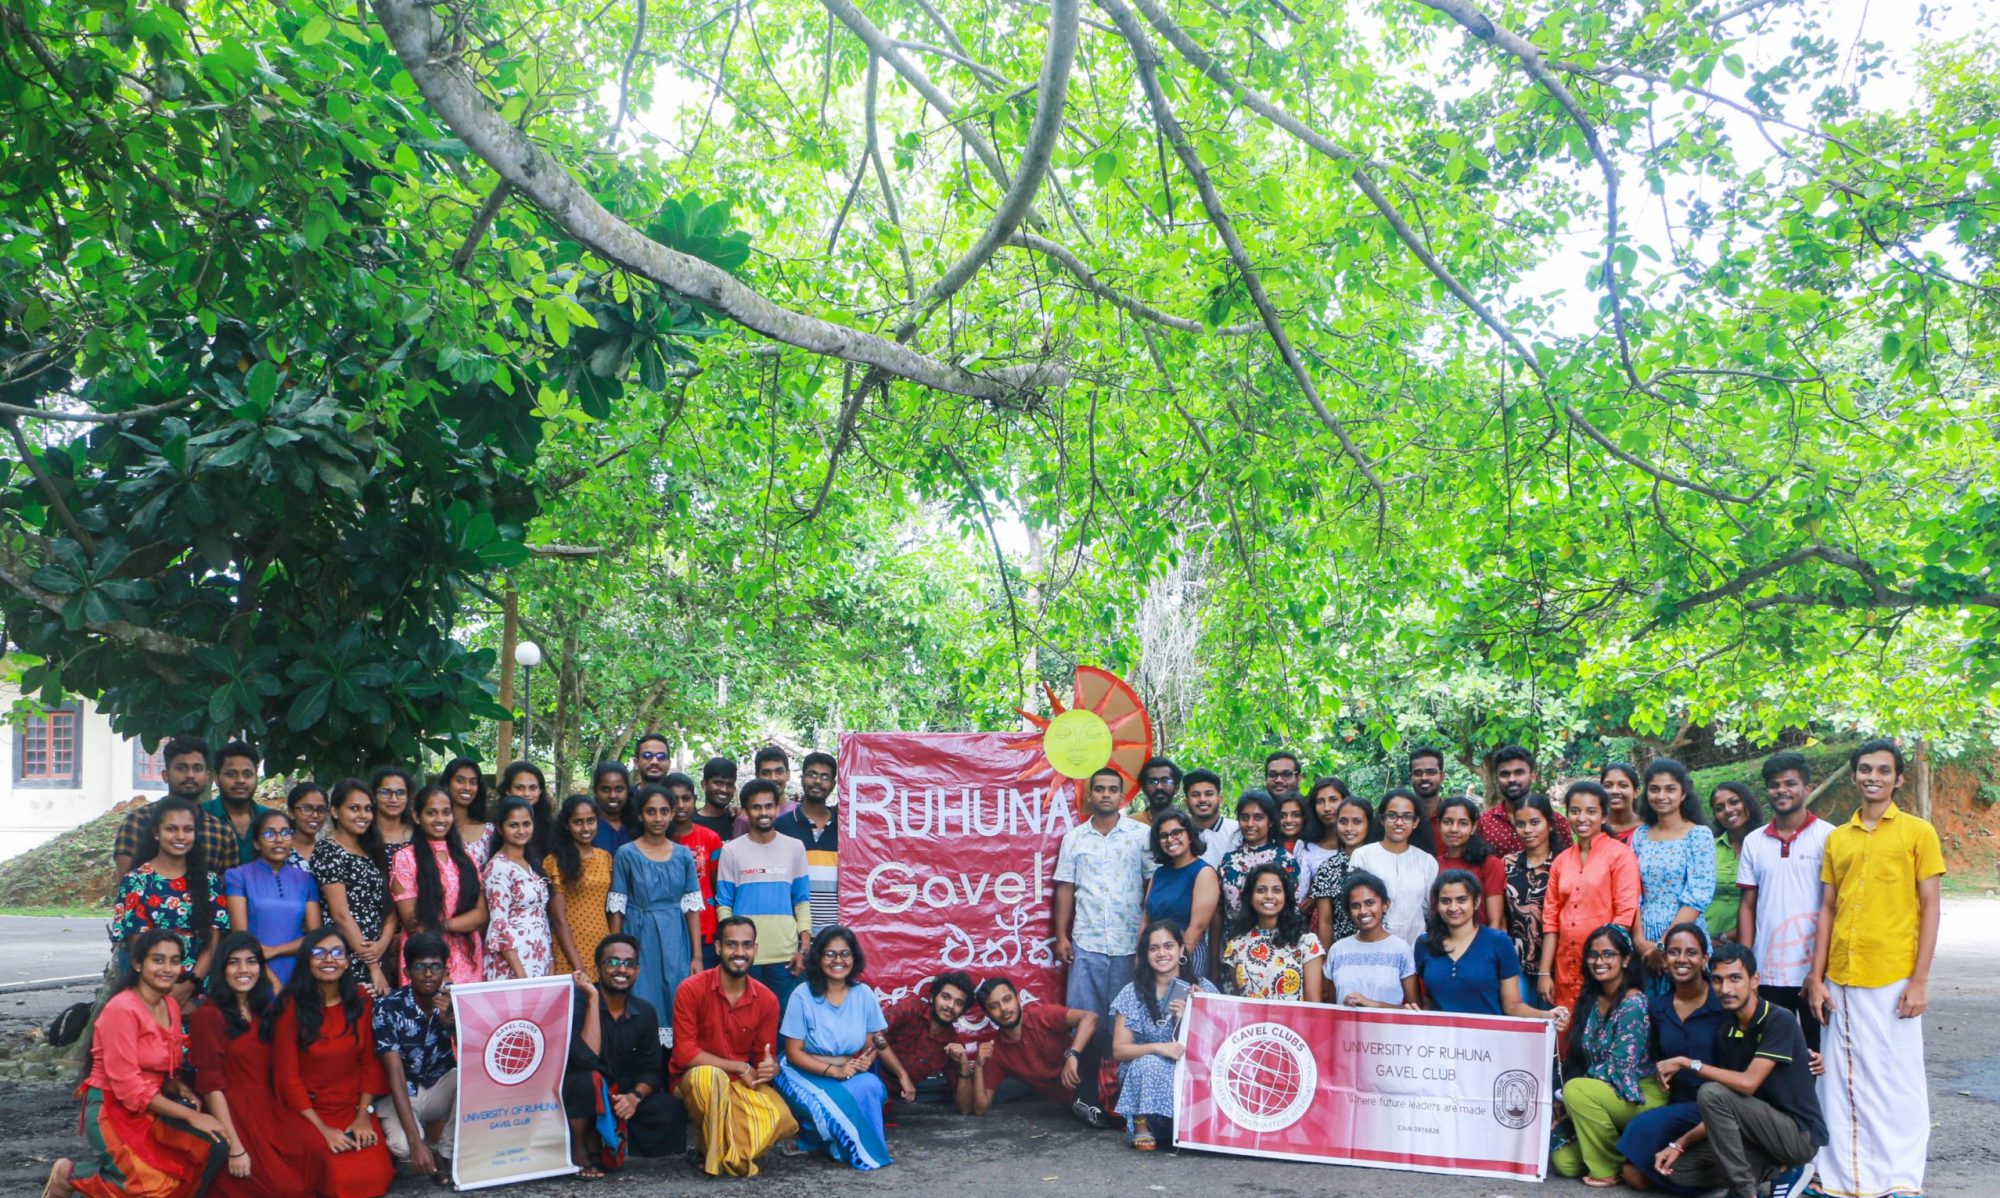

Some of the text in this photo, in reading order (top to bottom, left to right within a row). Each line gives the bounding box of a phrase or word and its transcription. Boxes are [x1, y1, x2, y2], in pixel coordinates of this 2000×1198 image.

[848, 775, 1075, 839] RUHUNA
[865, 852, 1044, 914] Gavel
[495, 1022, 538, 1037] GAVEL CLUBS
[1231, 1026, 1306, 1052] GAVEL CLUBS
[1342, 1040, 1493, 1063] UNIVERSITY OF RUHUNA
[1375, 1064, 1457, 1081] GAVEL CLUB
[463, 1103, 560, 1123] UNIVERSITY OF RUHUNA
[1379, 1096, 1407, 1108] future
[1408, 1099, 1441, 1112] leaders
[1443, 1104, 1458, 1113] are
[1459, 1104, 1487, 1116] made
[489, 1117, 531, 1130] GAVEL CLUB
